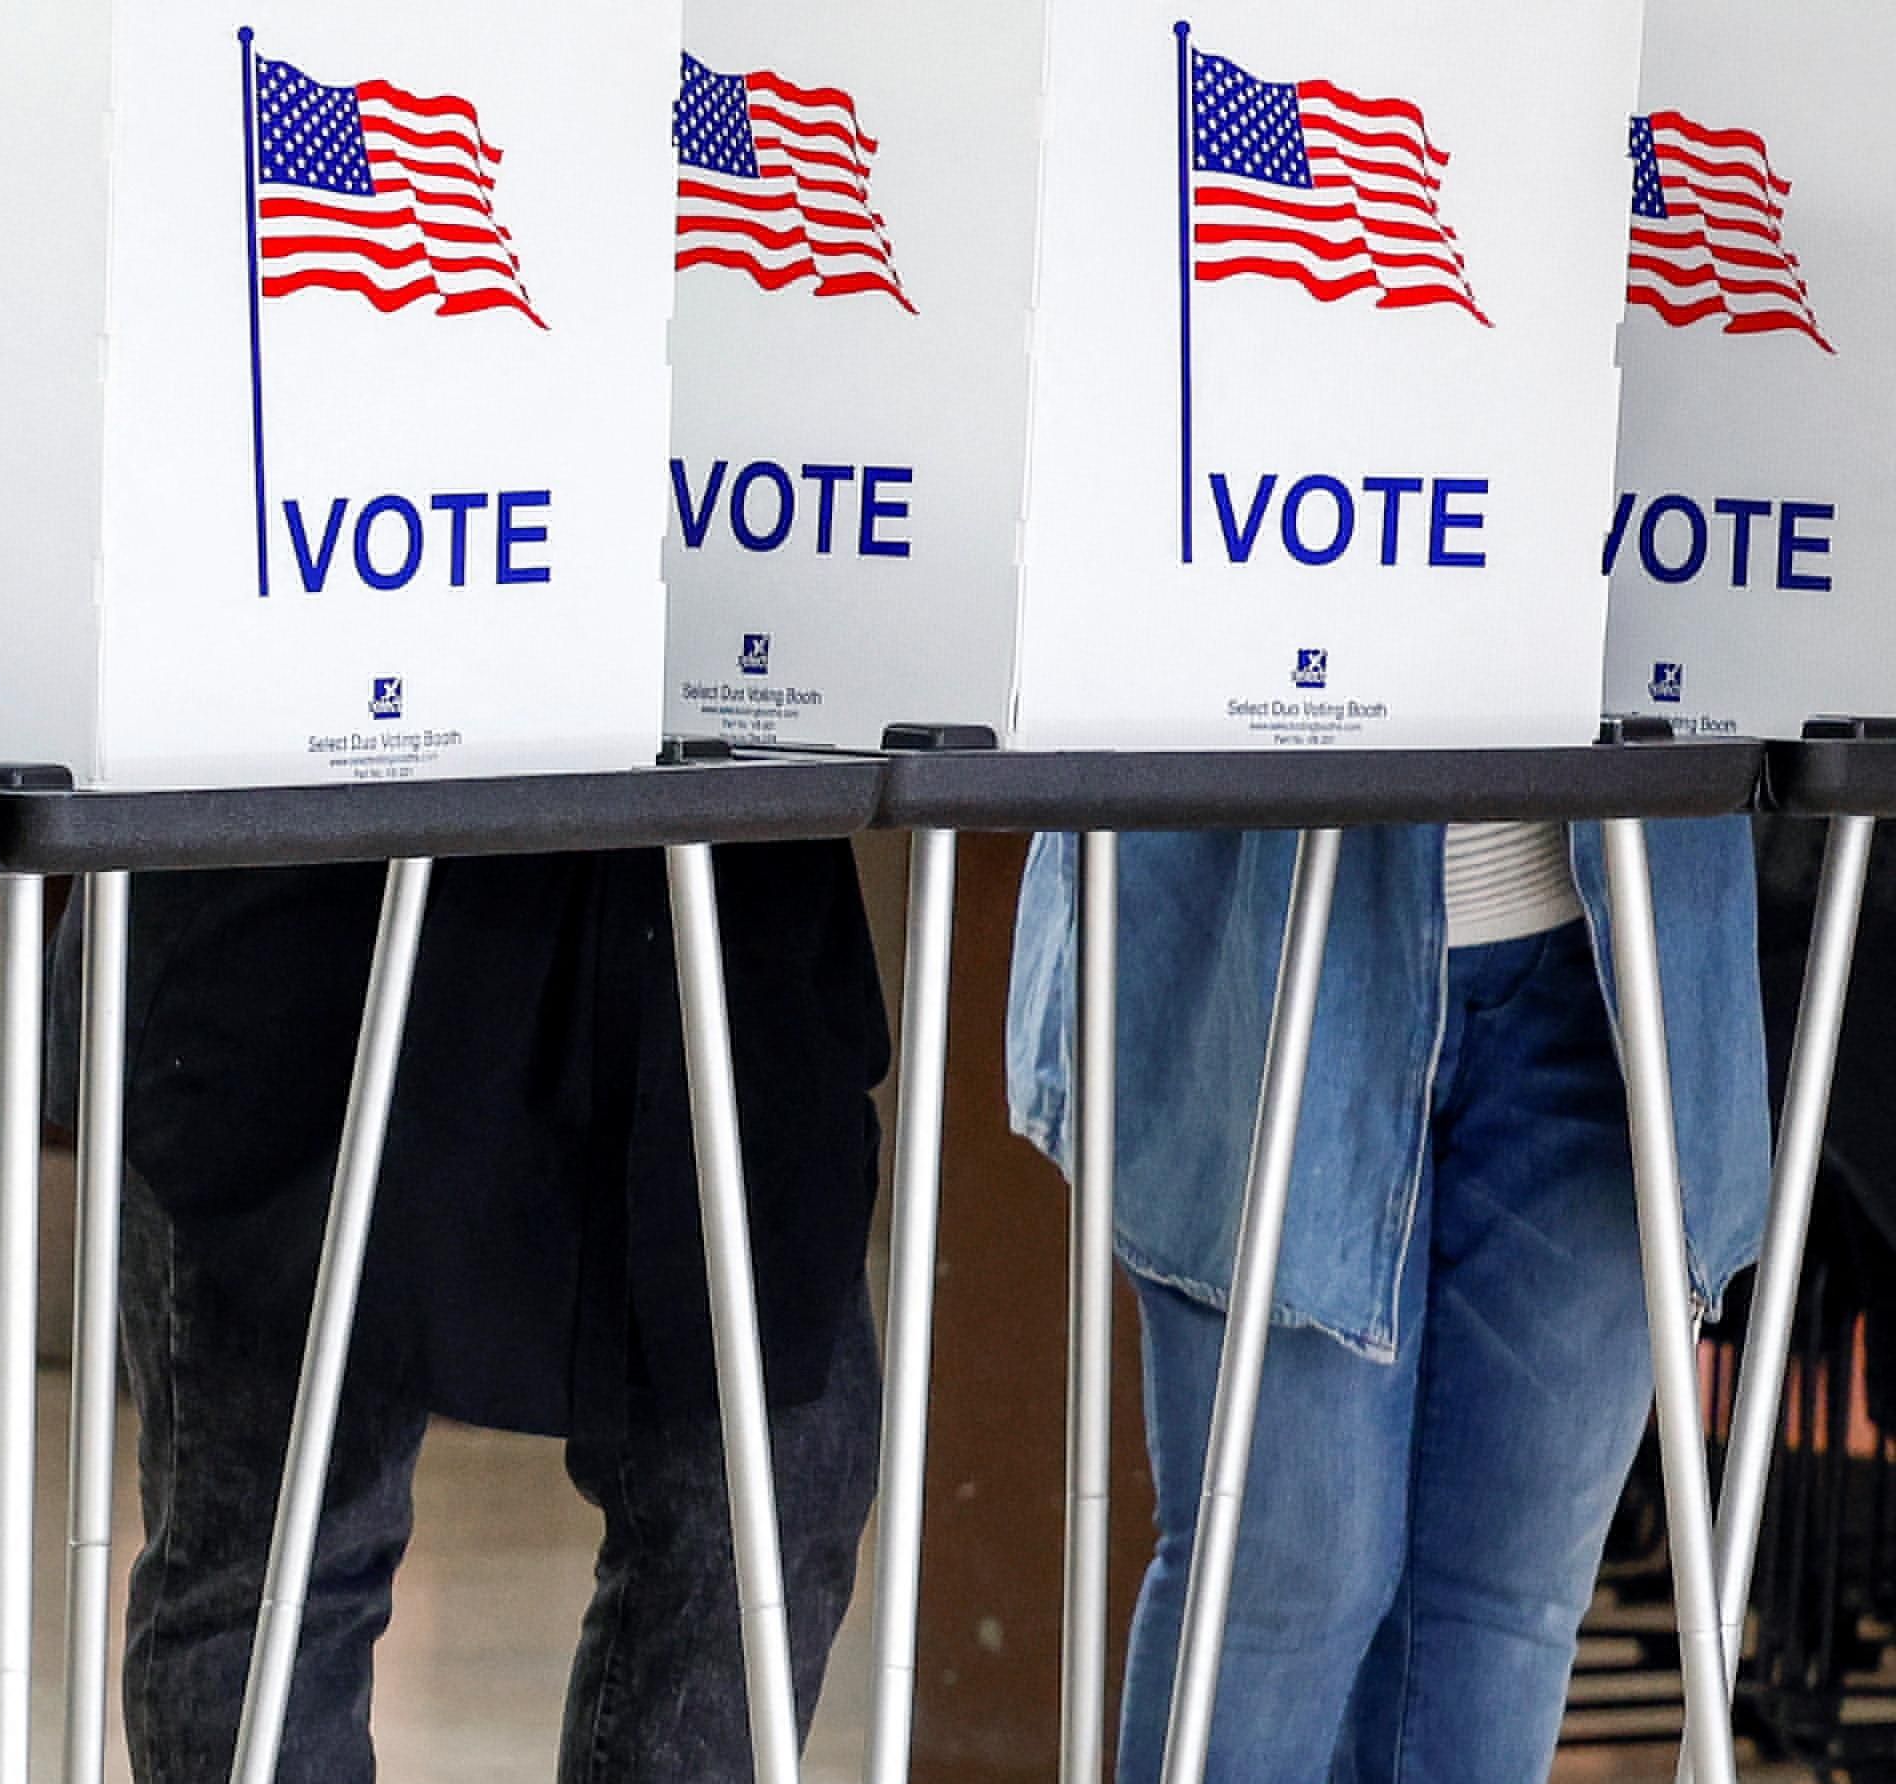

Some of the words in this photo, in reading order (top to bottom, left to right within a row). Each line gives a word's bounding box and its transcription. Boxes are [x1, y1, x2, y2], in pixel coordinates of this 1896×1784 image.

[670, 459, 913, 558] VOTE
[1210, 473, 1489, 568] VOTE
[282, 489, 551, 593] VOTE
[681, 682, 718, 700] Select
[720, 684, 745, 701] Duo
[745, 686, 785, 707] Voting
[786, 688, 823, 705] Booth
[1227, 700, 1268, 716] Select
[1272, 700, 1299, 716] Duo
[1303, 700, 1344, 720] Voting
[1347, 700, 1388, 718] Booth
[308, 735, 347, 752] Select
[351, 733, 377, 751] Duo
[380, 733, 421, 752] Voting
[424, 729, 462, 747] Booth
